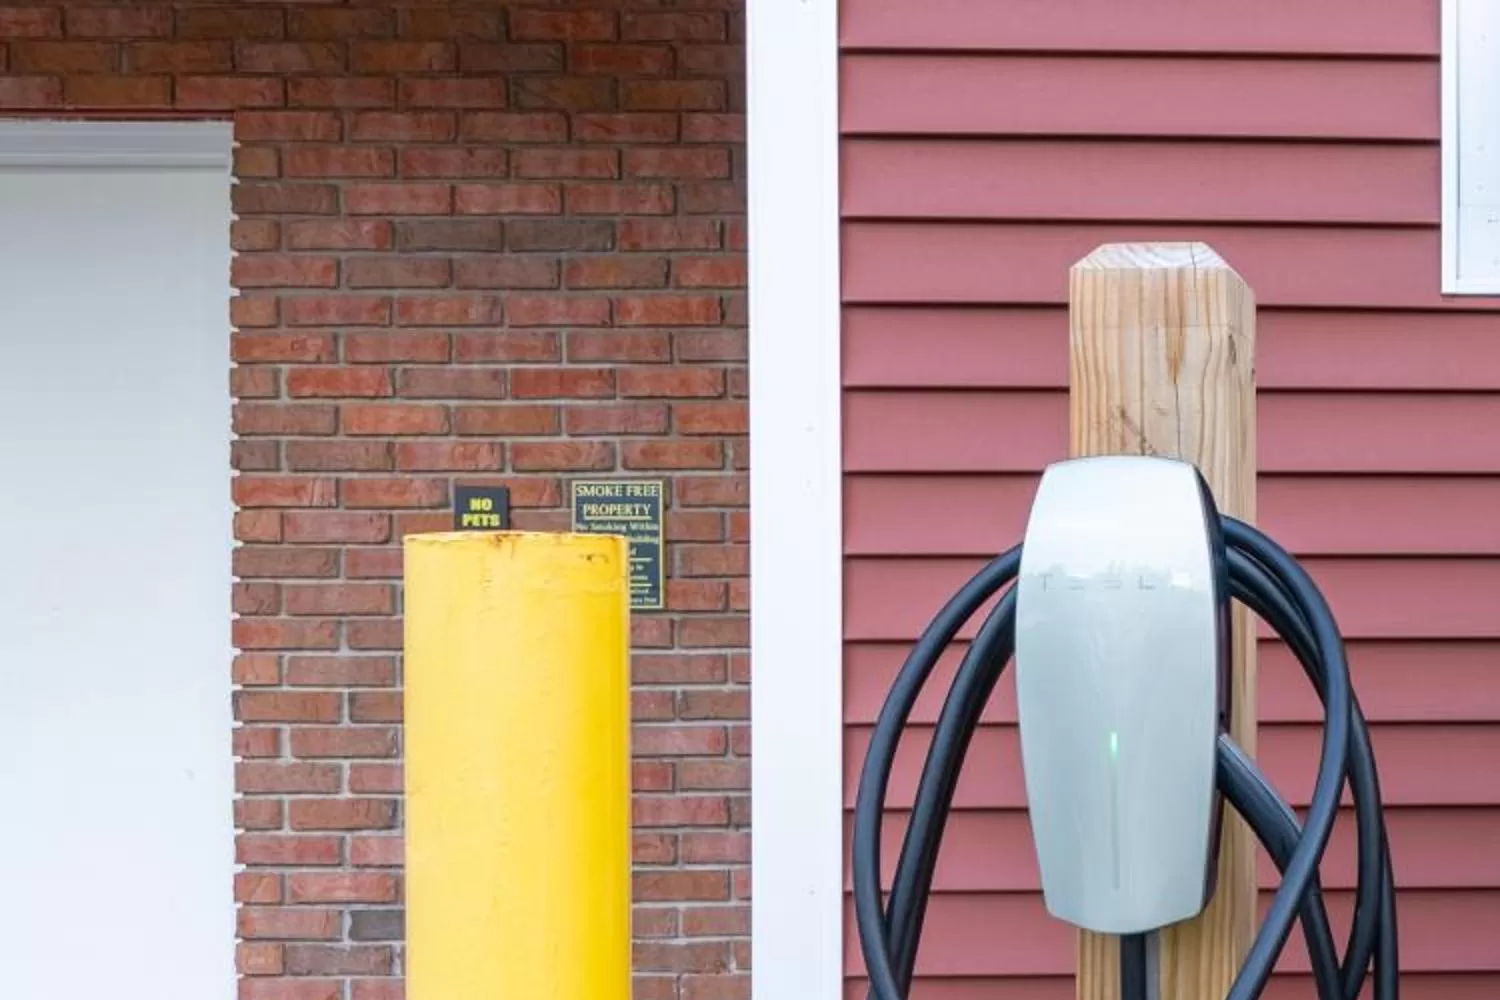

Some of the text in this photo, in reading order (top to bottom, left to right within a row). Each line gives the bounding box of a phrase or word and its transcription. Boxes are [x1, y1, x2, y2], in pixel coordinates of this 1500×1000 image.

[576, 485, 659, 497] SMOKE FREE
[470, 497, 493, 512] NO
[583, 503, 651, 516] PROPERTY
[462, 513, 500, 528] PETS
